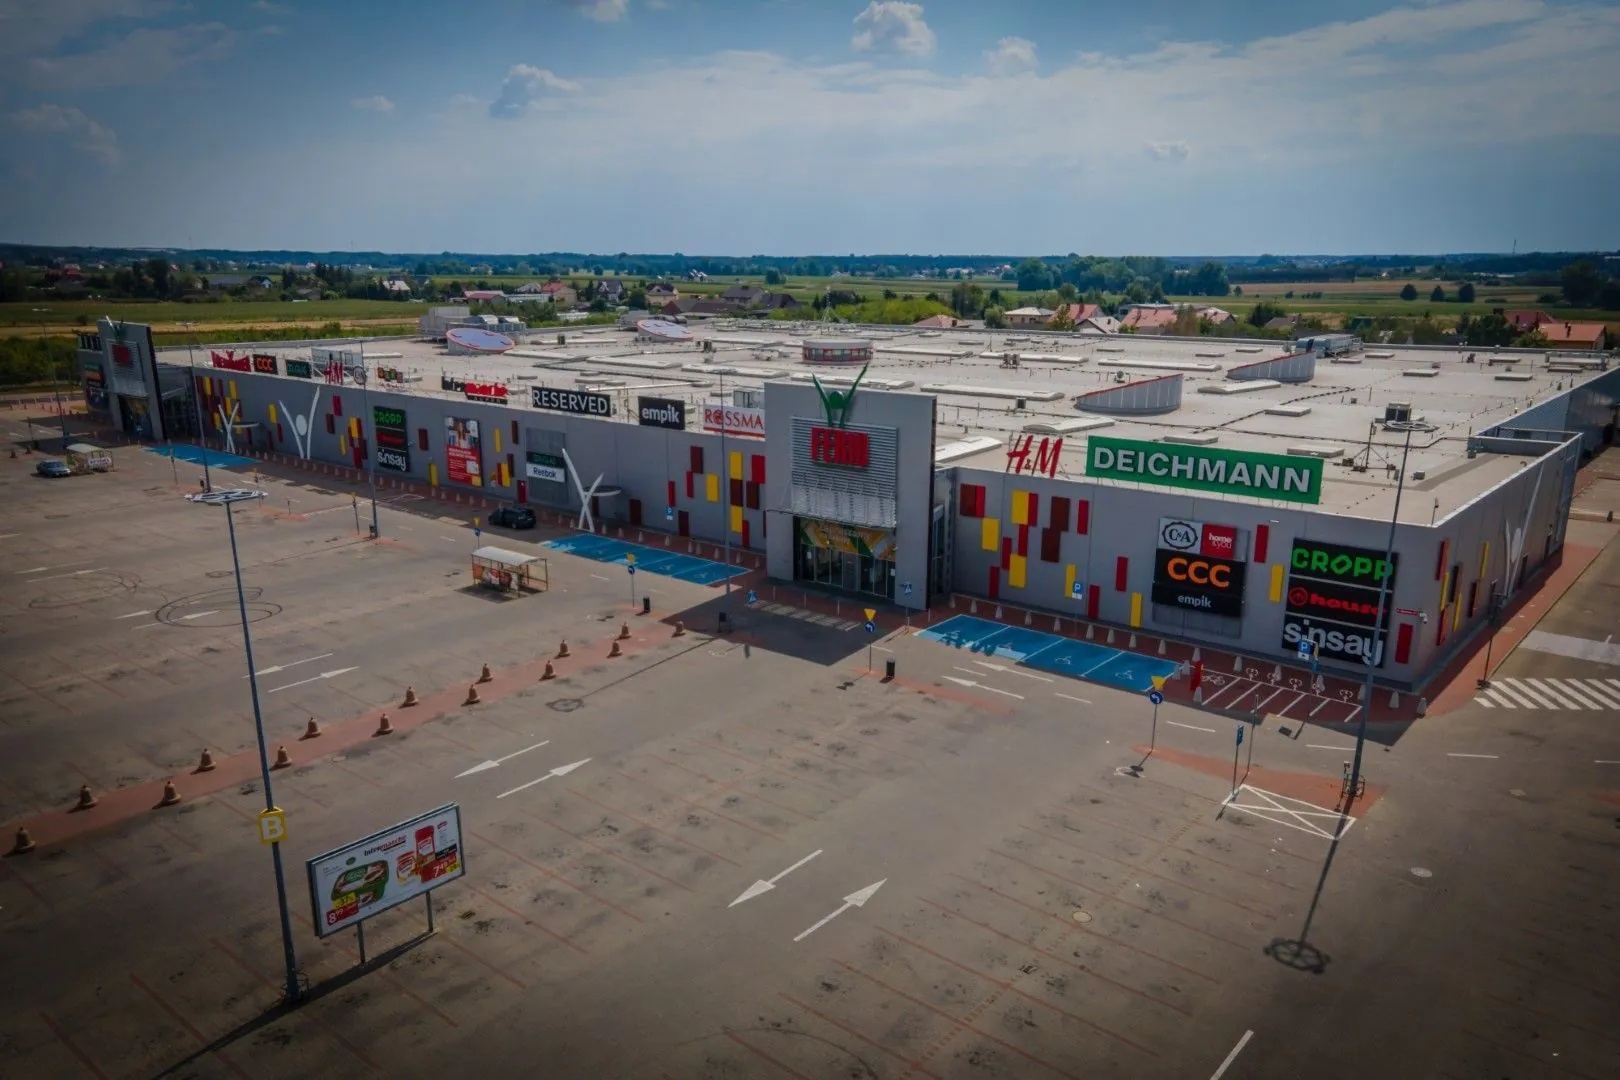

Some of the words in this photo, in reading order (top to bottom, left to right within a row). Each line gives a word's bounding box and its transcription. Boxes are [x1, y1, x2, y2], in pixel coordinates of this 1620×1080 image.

[533, 389, 608, 414] RESERVED
[641, 405, 680, 424] empik
[1006, 434, 1063, 478] H&M
[533, 467, 556, 478] Reebok
[1093, 446, 1311, 494] DEICHMANN
[1208, 532, 1232, 543] home
[1167, 557, 1232, 588] CCC
[1291, 547, 1394, 581] CROPP
[1178, 594, 1212, 609] empik
[263, 816, 284, 840] B
